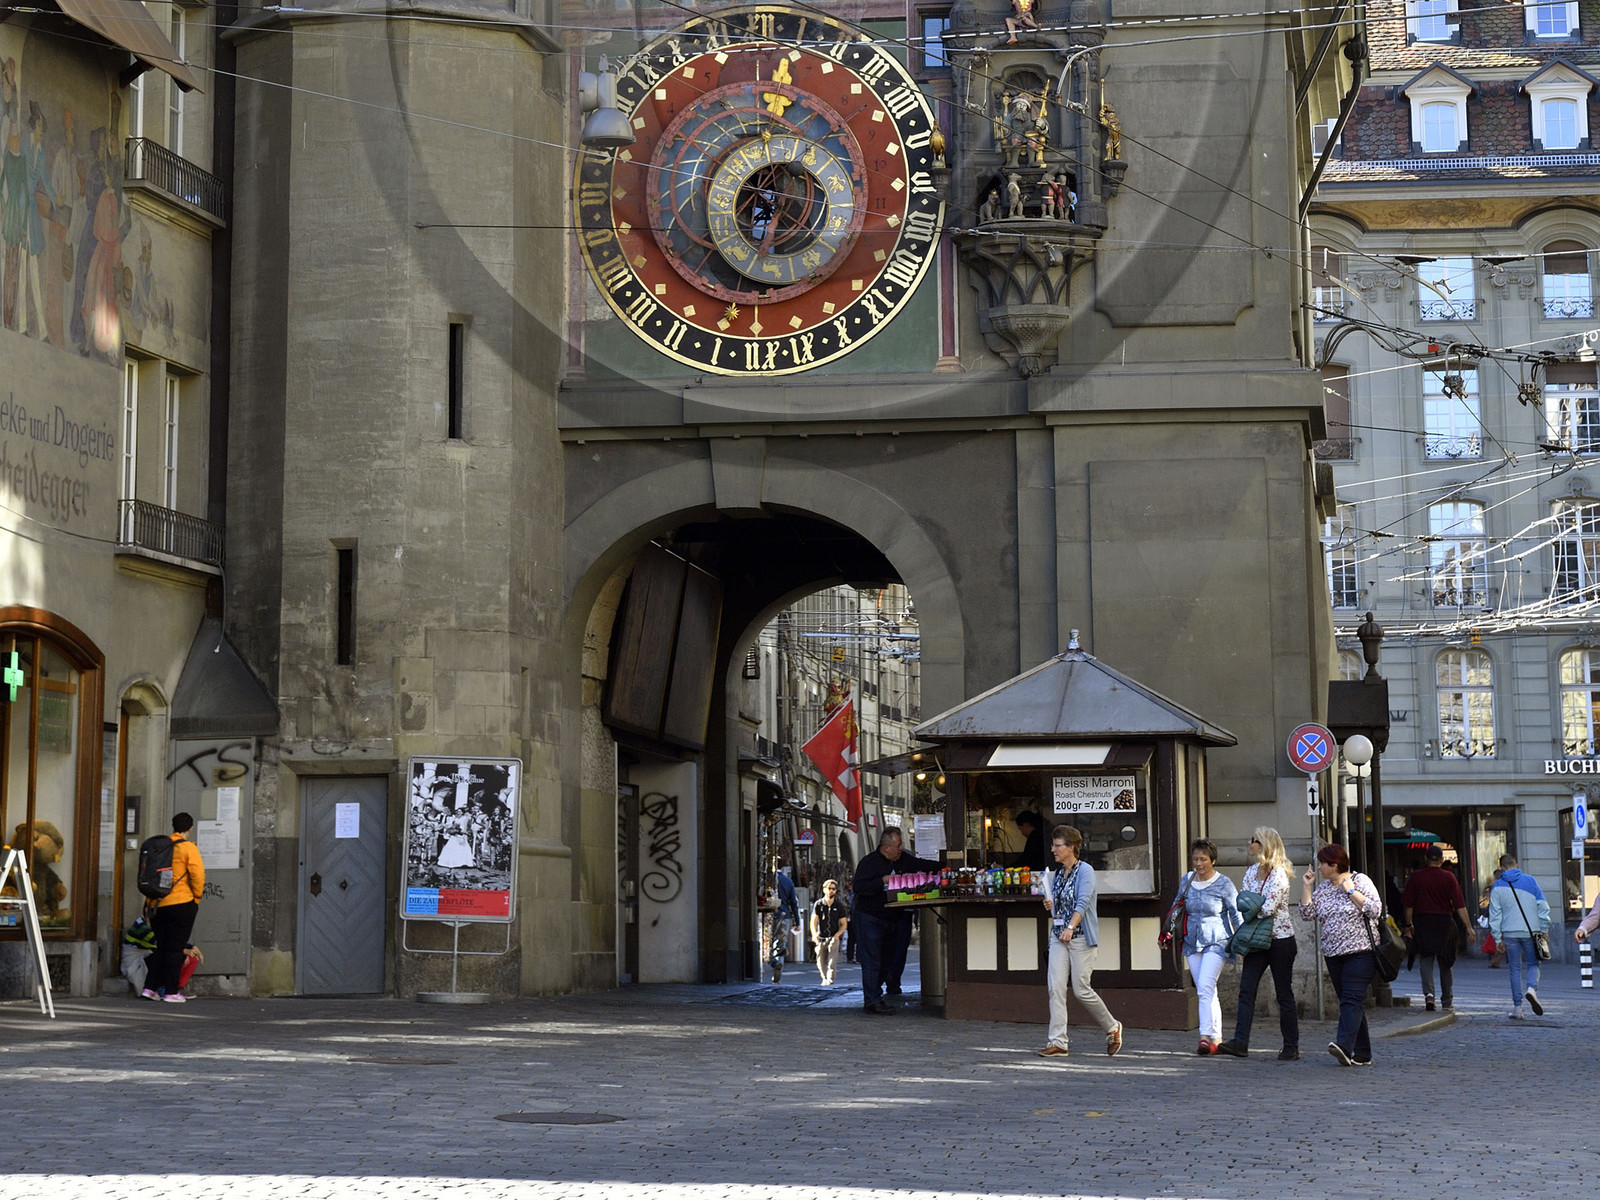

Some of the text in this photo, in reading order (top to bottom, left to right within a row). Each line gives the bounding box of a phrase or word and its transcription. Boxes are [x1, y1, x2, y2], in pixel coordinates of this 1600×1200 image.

[30, 414, 50, 443] und
[54, 405, 115, 468] Drogerie
[1544, 759, 1600, 774] BUCH
[1055, 777, 1134, 788] Heissi Marroni
[1055, 790, 1112, 799] Roast Chestnuts
[1055, 801, 1082, 811] 200gr
[423, 897, 475, 906] ZAUERFLÖTE
